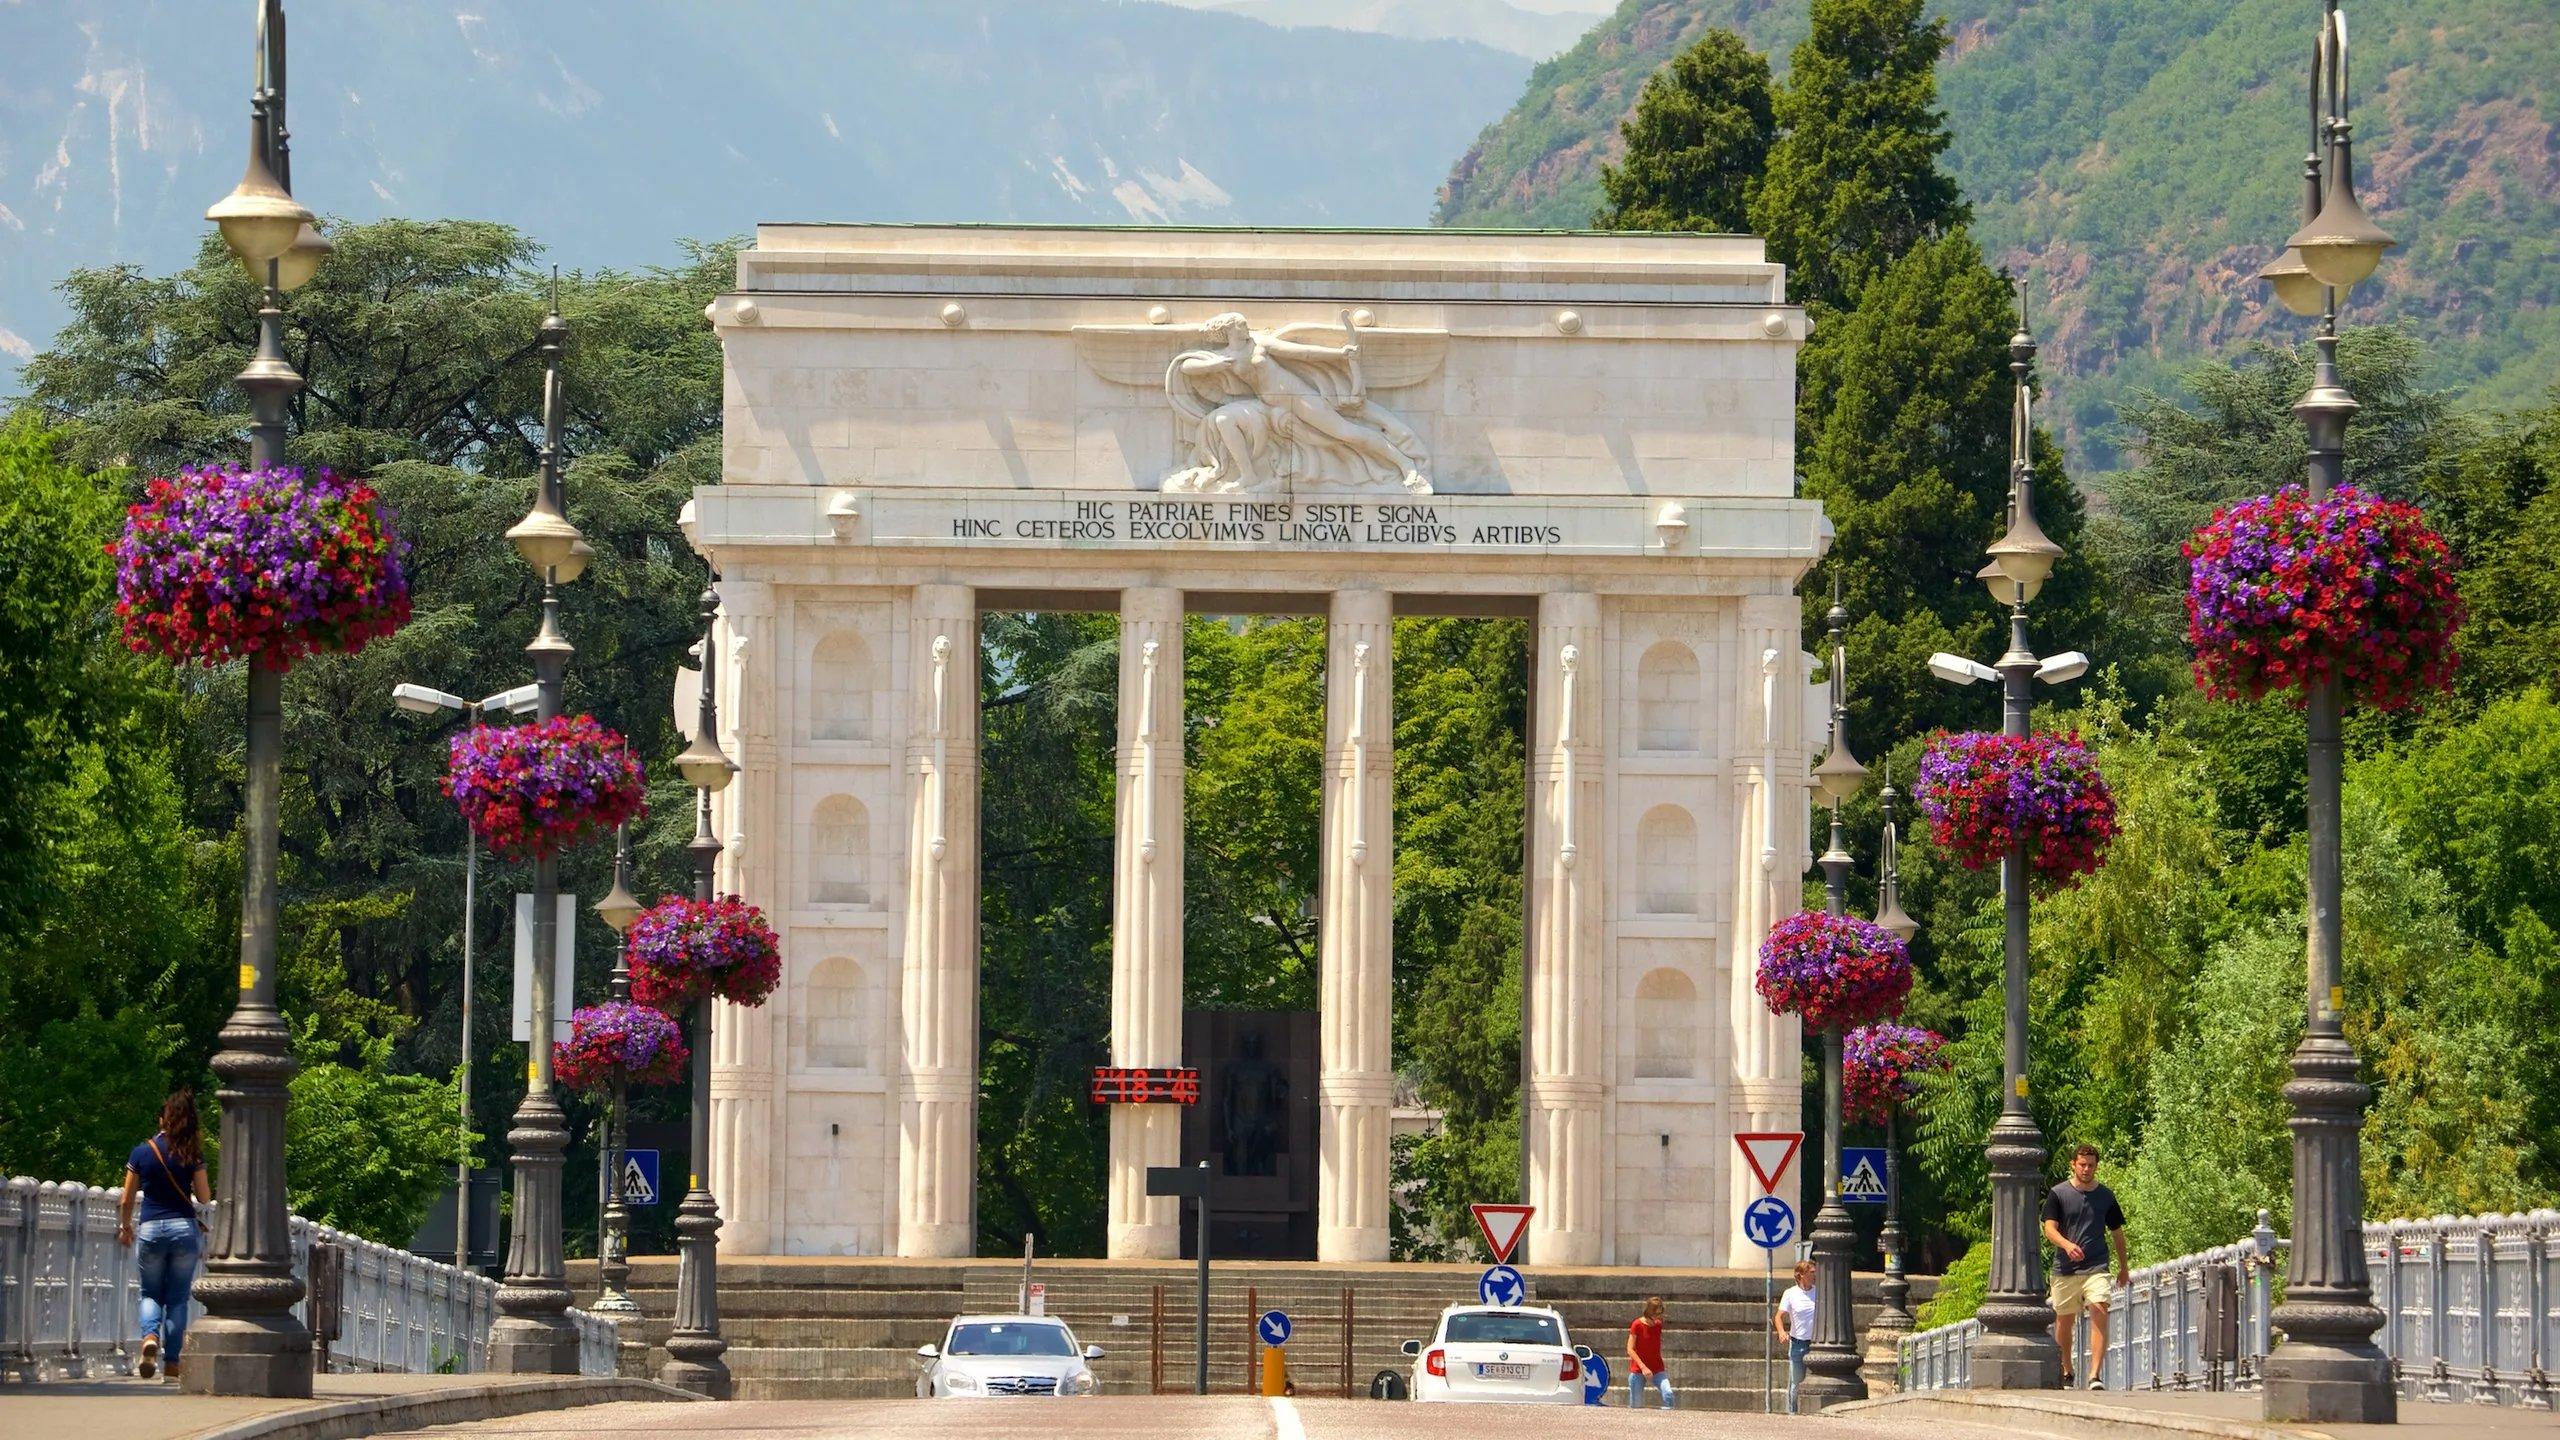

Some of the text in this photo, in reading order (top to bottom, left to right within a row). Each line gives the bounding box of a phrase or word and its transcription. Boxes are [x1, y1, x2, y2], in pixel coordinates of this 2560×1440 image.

[1077, 501, 1438, 524] HIC PATRIAE FINES SISTE SIGNA
[953, 519, 1561, 544] HINC CETEROS EXCOLVIMVS LINGVA LEGIBVS ARTIBVS
